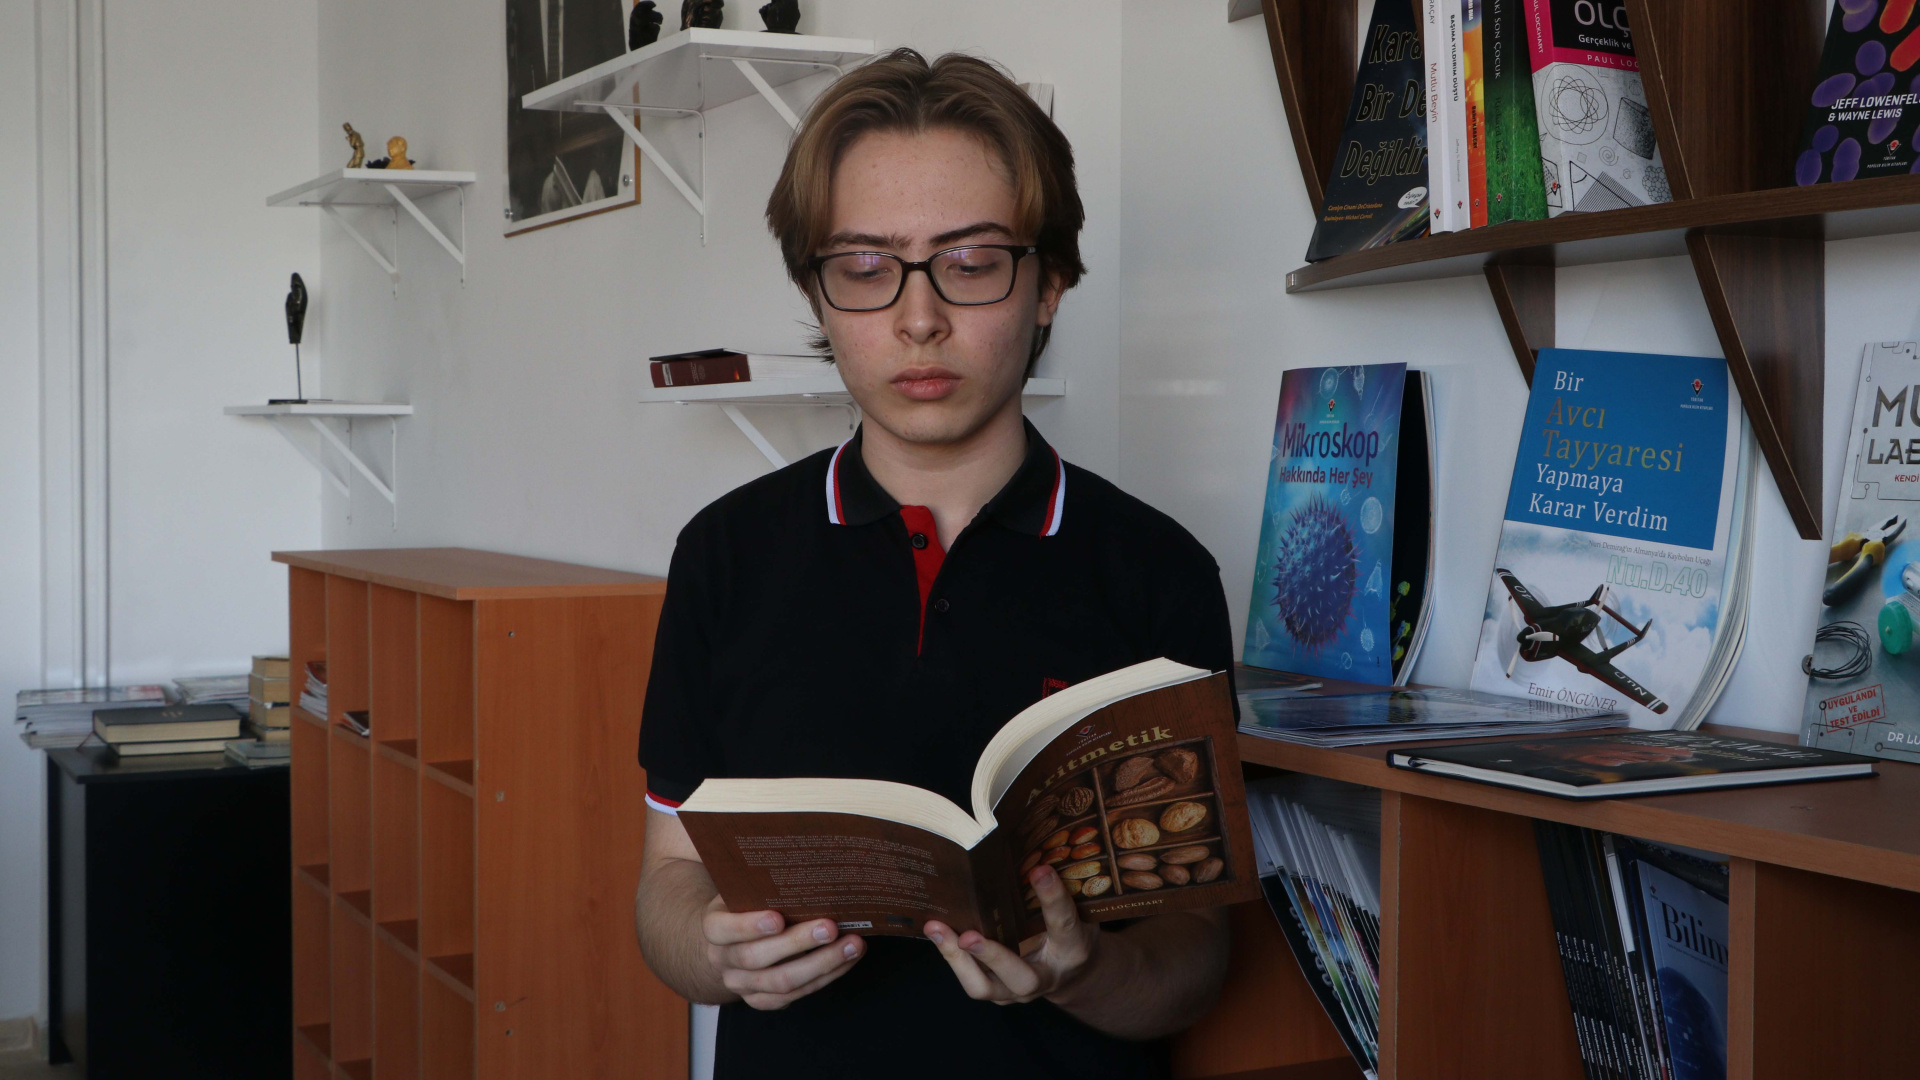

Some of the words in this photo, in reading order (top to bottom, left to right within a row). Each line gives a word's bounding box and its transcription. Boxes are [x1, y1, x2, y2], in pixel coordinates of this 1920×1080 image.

[1494, 17, 1502, 39] SON
[1534, 12, 1544, 54] LOCKHART
[1578, 34, 1620, 48] Gerçeklik
[1621, 42, 1632, 50] ve
[1368, 24, 1422, 64] Kara
[1494, 41, 1502, 79] ÇOCUK
[1586, 54, 1614, 65] PAUL
[1430, 62, 1438, 92] Mutlu
[1356, 83, 1395, 122] Bir
[1430, 94, 1438, 123] Beyin
[1827, 112, 1836, 122] &
[1837, 110, 1870, 121] WAYNE
[1871, 108, 1903, 120] LEWIS
[1831, 97, 1859, 110] JEFF
[1859, 93, 1920, 109] LOWENFEL
[1339, 136, 1428, 186] Değildir
[1553, 370, 1585, 393] Bir
[1545, 397, 1607, 430] Avcı
[1282, 422, 1379, 467] Mikroskop
[1541, 428, 1685, 473] Tayyaresi
[1279, 466, 1326, 484] Hakkında
[1329, 467, 1350, 484] Her
[1351, 468, 1374, 489] Şey
[1536, 463, 1624, 496] Yapmaya
[1894, 473, 1920, 482] KENDİ
[1528, 492, 1586, 520] Karar
[1592, 501, 1668, 532] Verdim
[1634, 547, 1666, 558] Almanya'da
[1667, 551, 1694, 563] Kaybolan
[1605, 554, 1709, 599] Nu.D.40
[1528, 682, 1555, 698] Emir
[1557, 687, 1617, 711] ÖNGÜNER
[1828, 688, 1877, 709] UYGULANDI
[1848, 705, 1858, 713] VE
[1830, 716, 1850, 728] TEST
[1852, 706, 1881, 722] EDİLDİ
[1887, 731, 1905, 743] DR
[1024, 726, 1173, 807] Aritmetik
[1089, 906, 1109, 914] Paul
[1111, 899, 1164, 911] LOCKHART
[1659, 900, 1728, 967] Bilim
